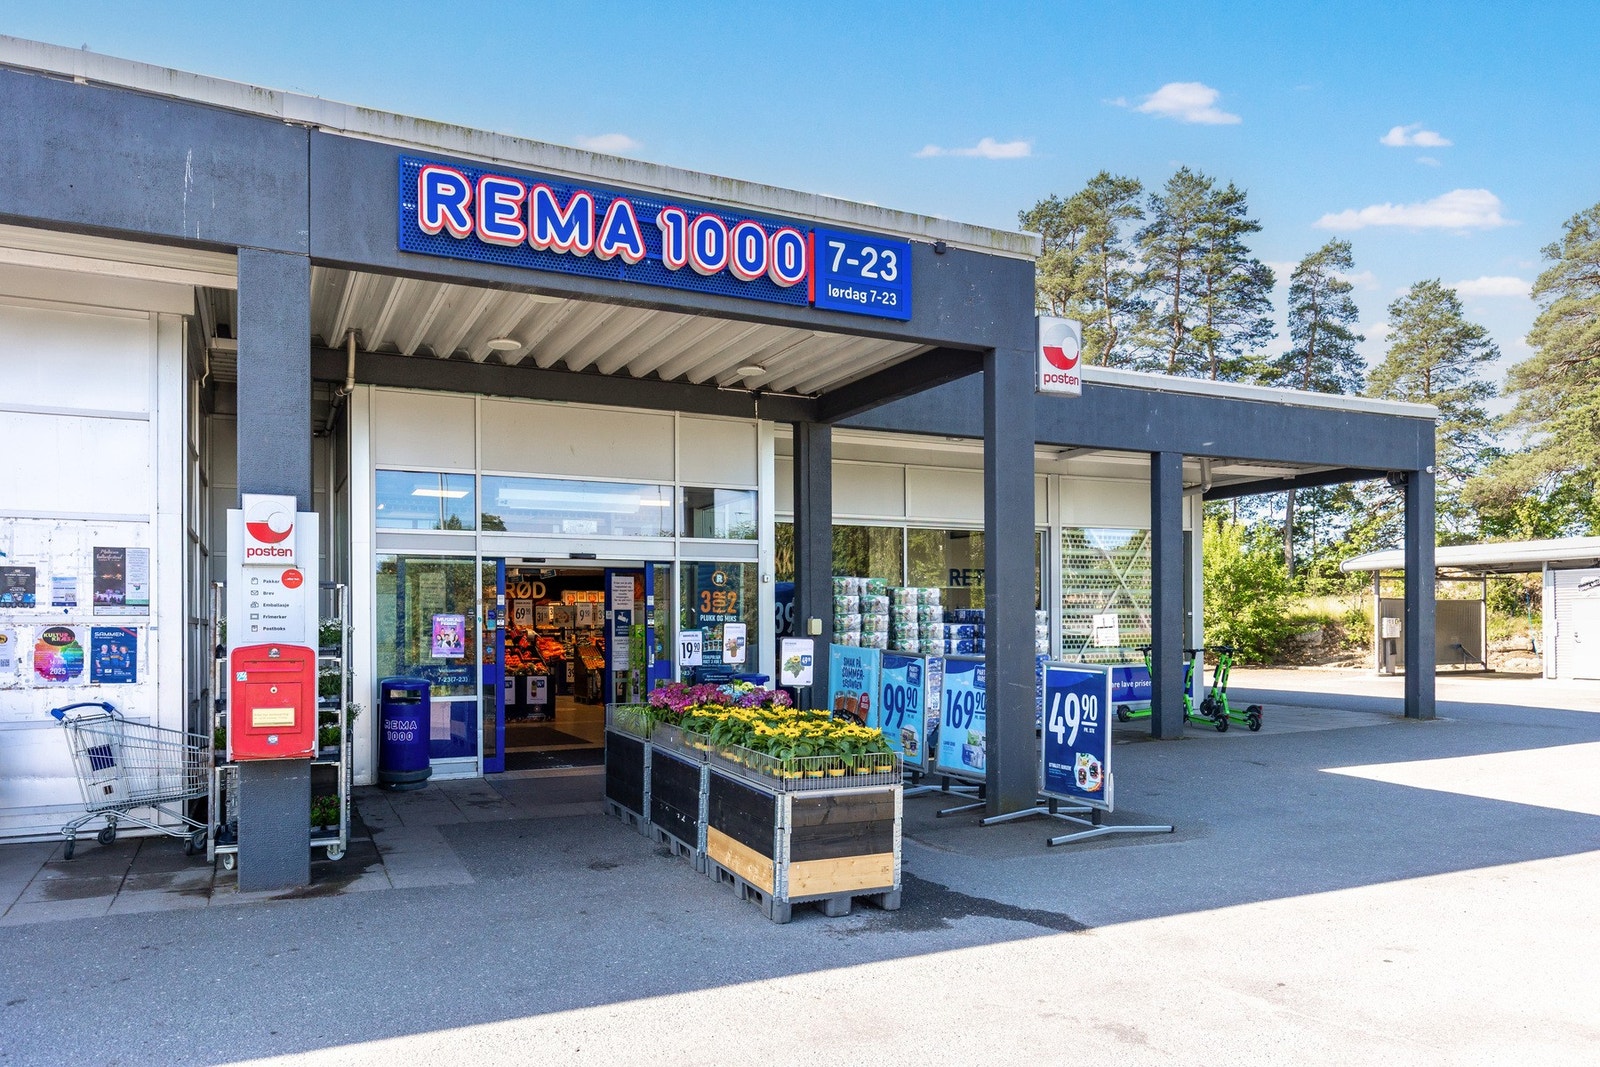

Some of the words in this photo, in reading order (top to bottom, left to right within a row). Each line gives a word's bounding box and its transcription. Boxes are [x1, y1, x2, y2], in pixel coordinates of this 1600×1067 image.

[418, 164, 647, 265] REMA
[656, 206, 811, 288] 1000
[828, 240, 898, 282] 7-23
[828, 284, 867, 303] lørdag
[870, 289, 897, 306] 7-23
[1043, 372, 1079, 386] posten
[246, 545, 293, 558] posten
[700, 590, 711, 614] 3
[727, 591, 737, 614] 2
[515, 607, 526, 620] 69
[700, 614, 716, 622] PLUKK
[681, 642, 693, 659] 19
[693, 642, 701, 652] 90
[843, 657, 855, 666] SMAK
[49, 667, 66, 675] 2025
[842, 668, 865, 680] SOMMER-
[884, 683, 906, 730] 99
[906, 686, 918, 710] 90
[946, 689, 975, 730] 169
[384, 720, 417, 730] REMA
[1048, 692, 1080, 748] 49
[1081, 694, 1098, 721] 90
[387, 731, 413, 741] 1000
